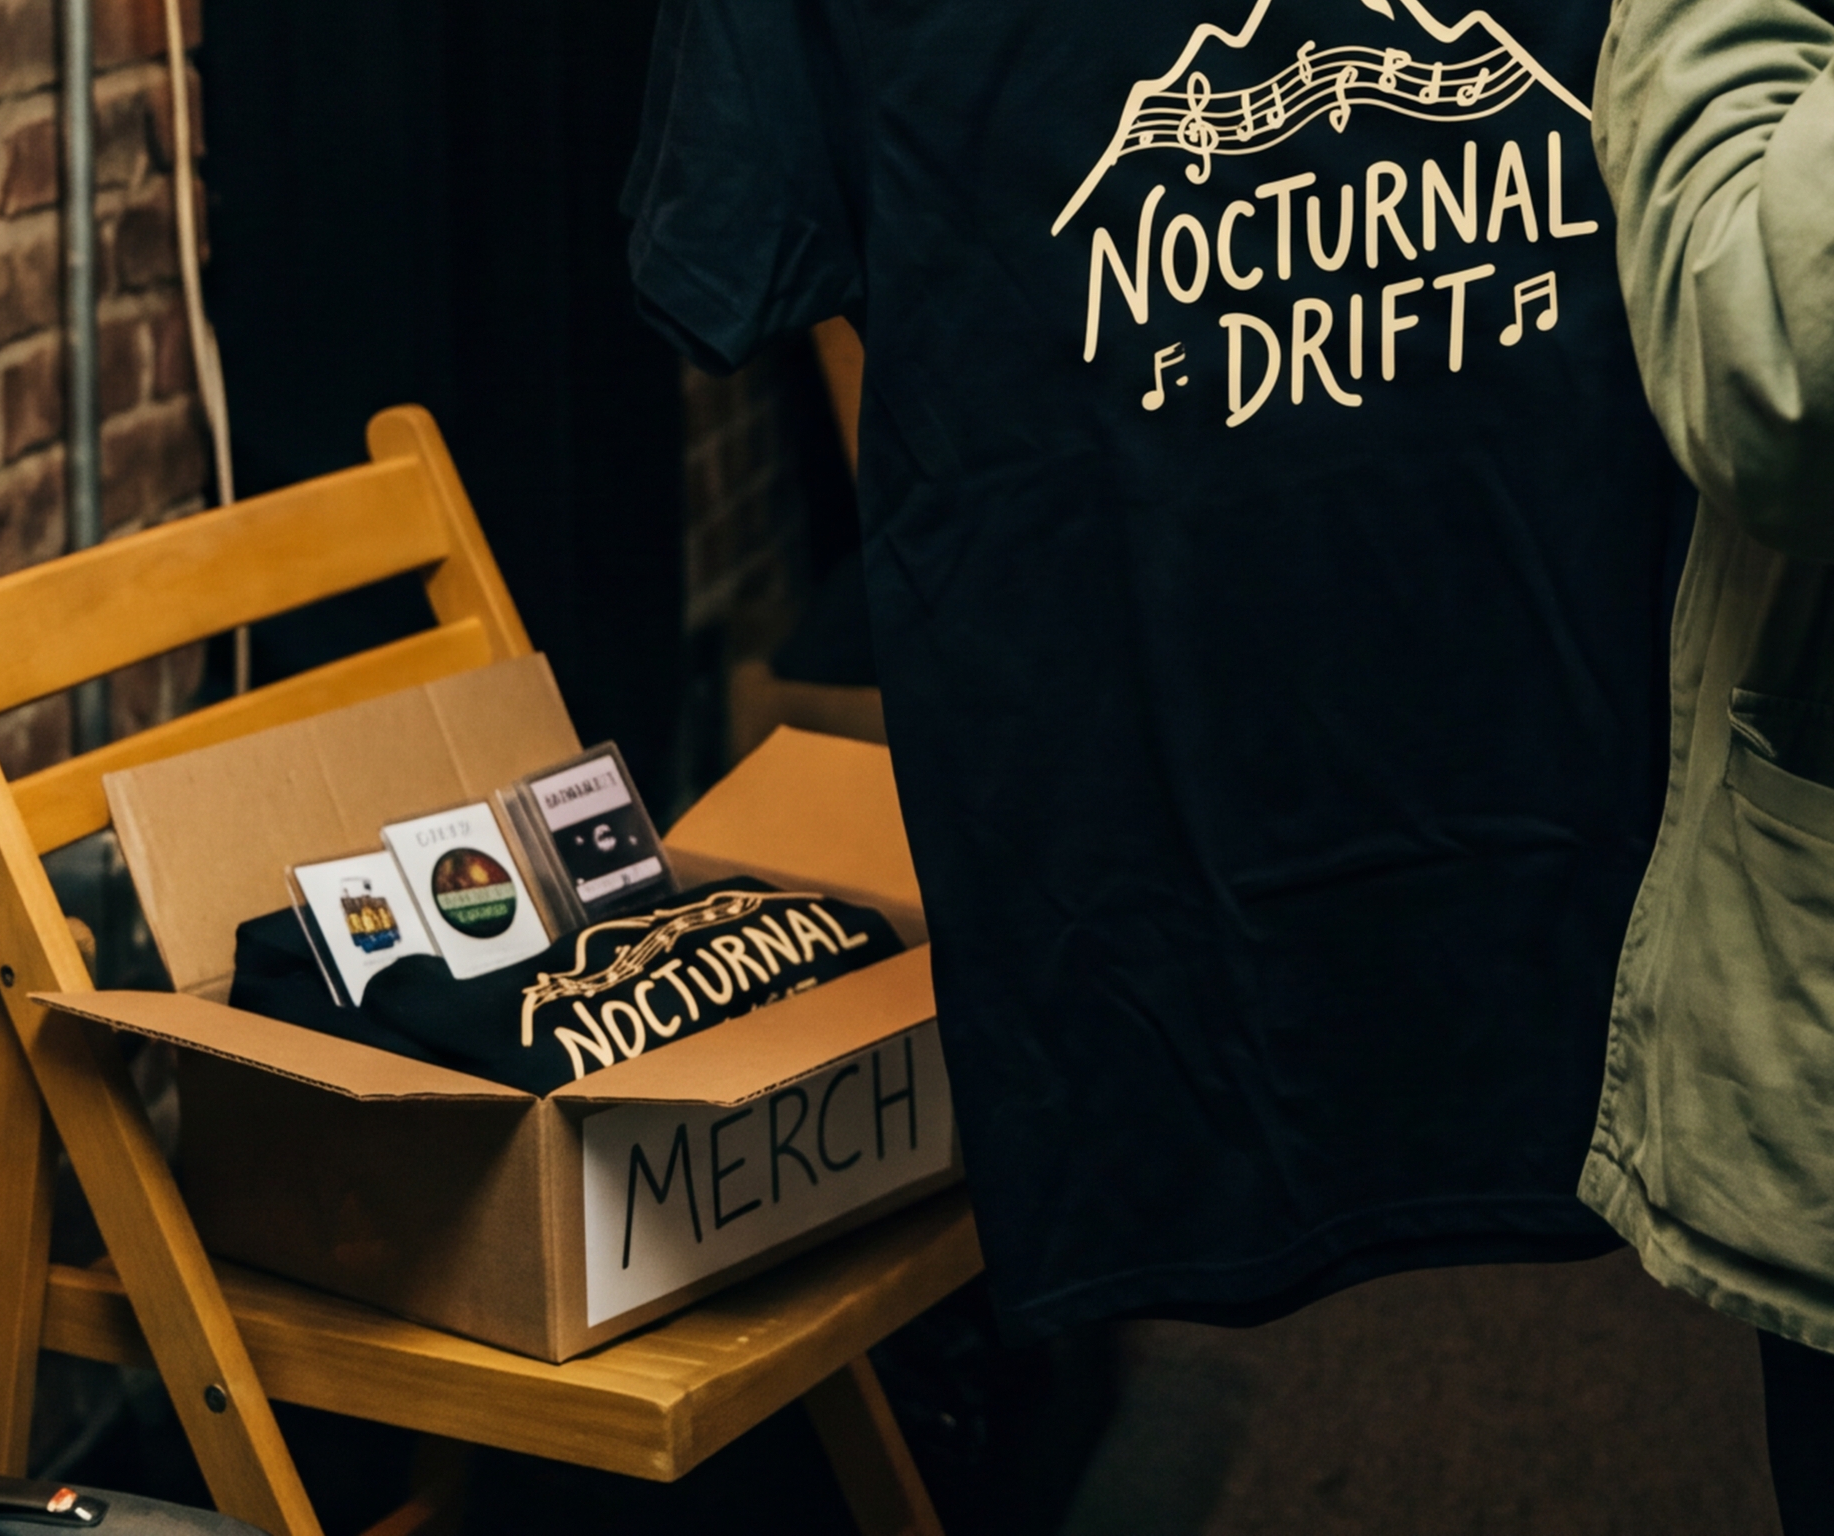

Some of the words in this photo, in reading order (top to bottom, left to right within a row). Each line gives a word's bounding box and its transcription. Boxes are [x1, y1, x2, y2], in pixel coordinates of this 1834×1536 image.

[1082, 130, 1599, 363] NOCTURNAL
[1219, 264, 1496, 428] DRIFT
[554, 902, 869, 1080] NOCTURNAL
[622, 1035, 917, 1270] MERCH
